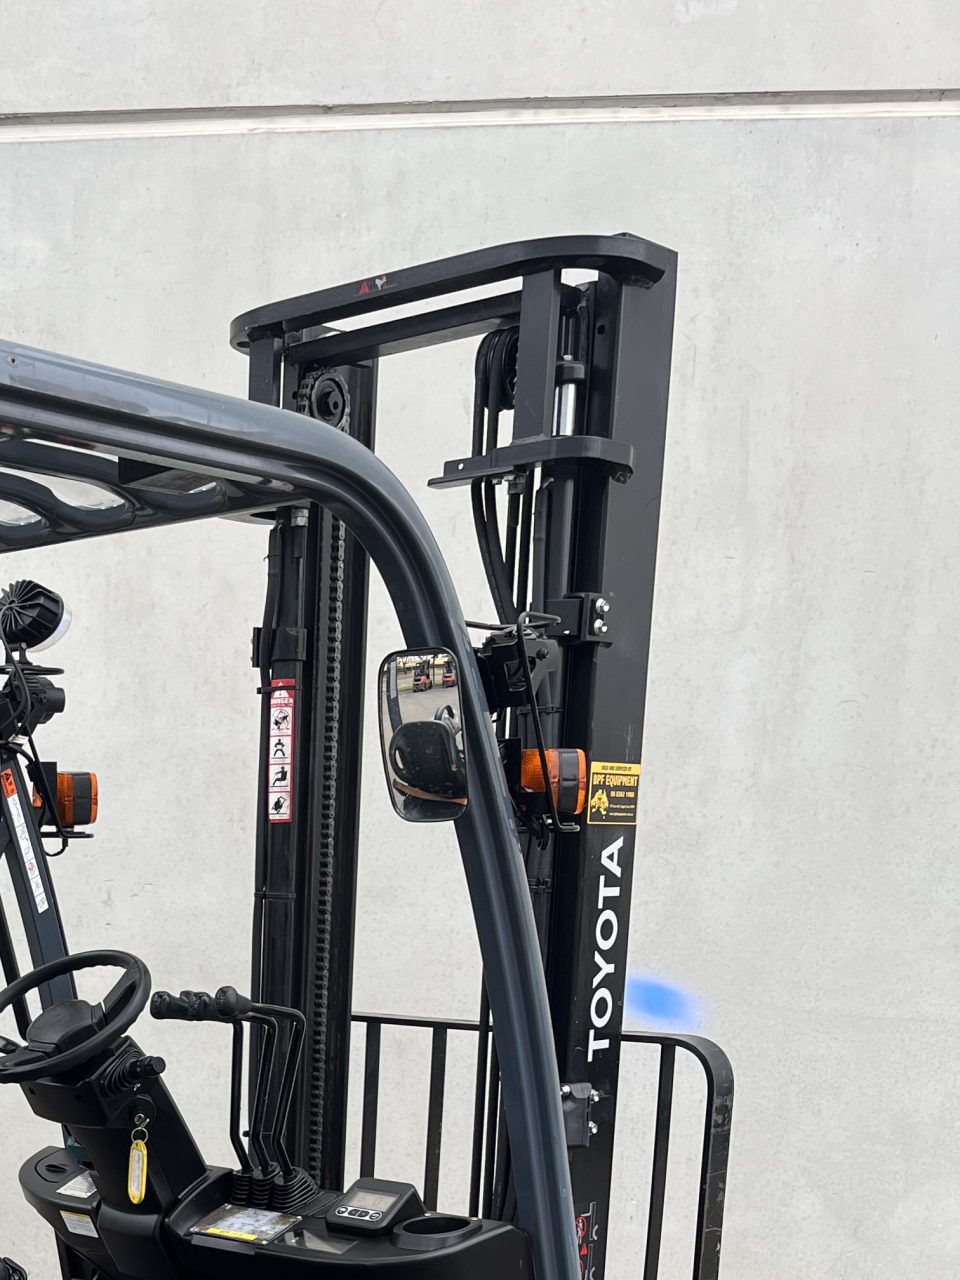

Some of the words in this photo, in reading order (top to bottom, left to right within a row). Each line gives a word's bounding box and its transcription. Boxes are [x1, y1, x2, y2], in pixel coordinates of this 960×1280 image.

[592, 774, 605, 786] BPF
[605, 775, 638, 787] EQUIPMENT
[587, 836, 624, 1063] TOYOTA
